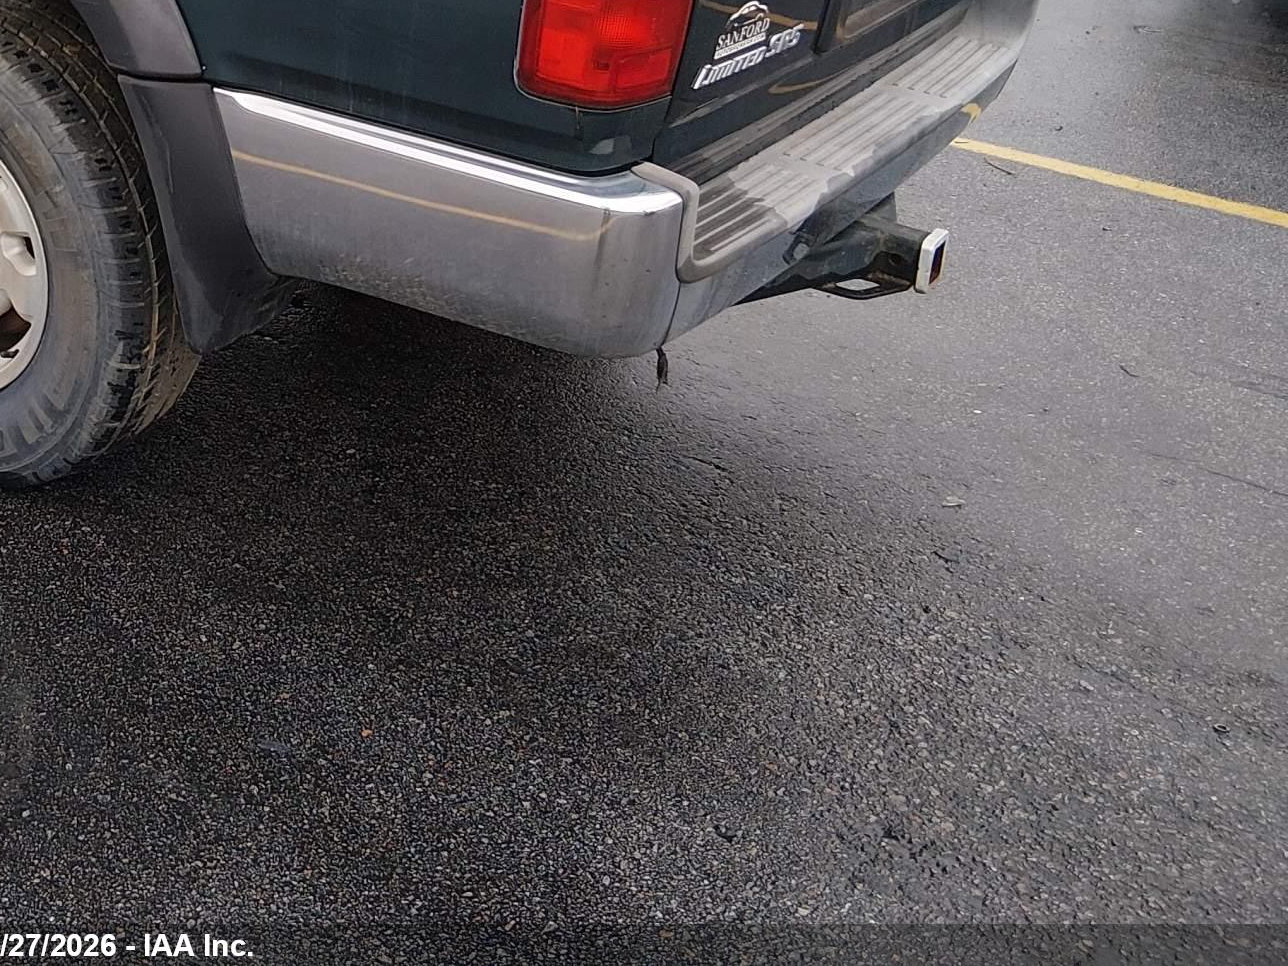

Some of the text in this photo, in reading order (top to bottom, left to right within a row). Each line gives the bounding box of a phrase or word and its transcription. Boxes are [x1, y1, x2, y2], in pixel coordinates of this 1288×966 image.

[692, 46, 768, 90] LIMITED
[765, 23, 805, 58] SR5
[716, 17, 771, 50] SANFORD
